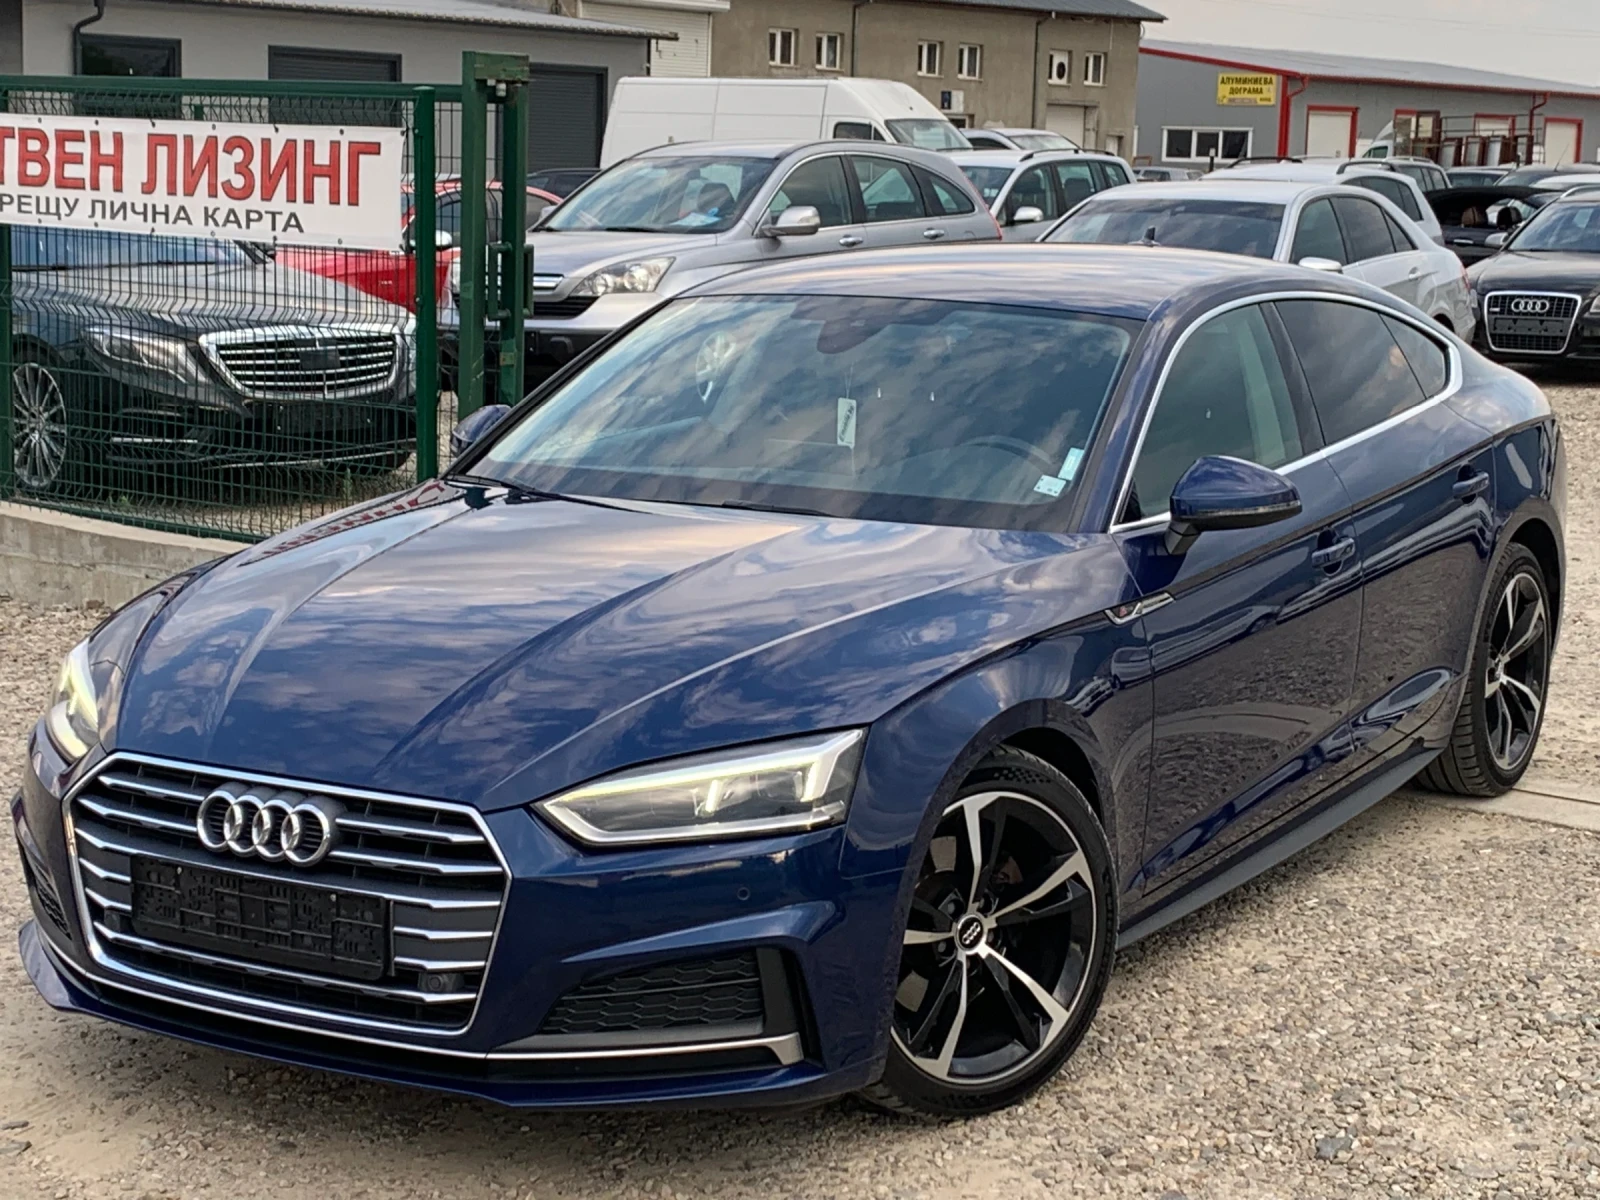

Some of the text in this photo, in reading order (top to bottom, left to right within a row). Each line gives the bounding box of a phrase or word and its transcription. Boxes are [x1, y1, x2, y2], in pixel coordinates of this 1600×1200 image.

[1220, 76, 1273, 85] АЛУМИНИЕВА
[1229, 86, 1263, 95] ДОГРАМА
[141, 133, 381, 206] ЛИЗИНГ
[88, 199, 193, 226] ЛИЧНА
[203, 206, 305, 233] КАРТА
